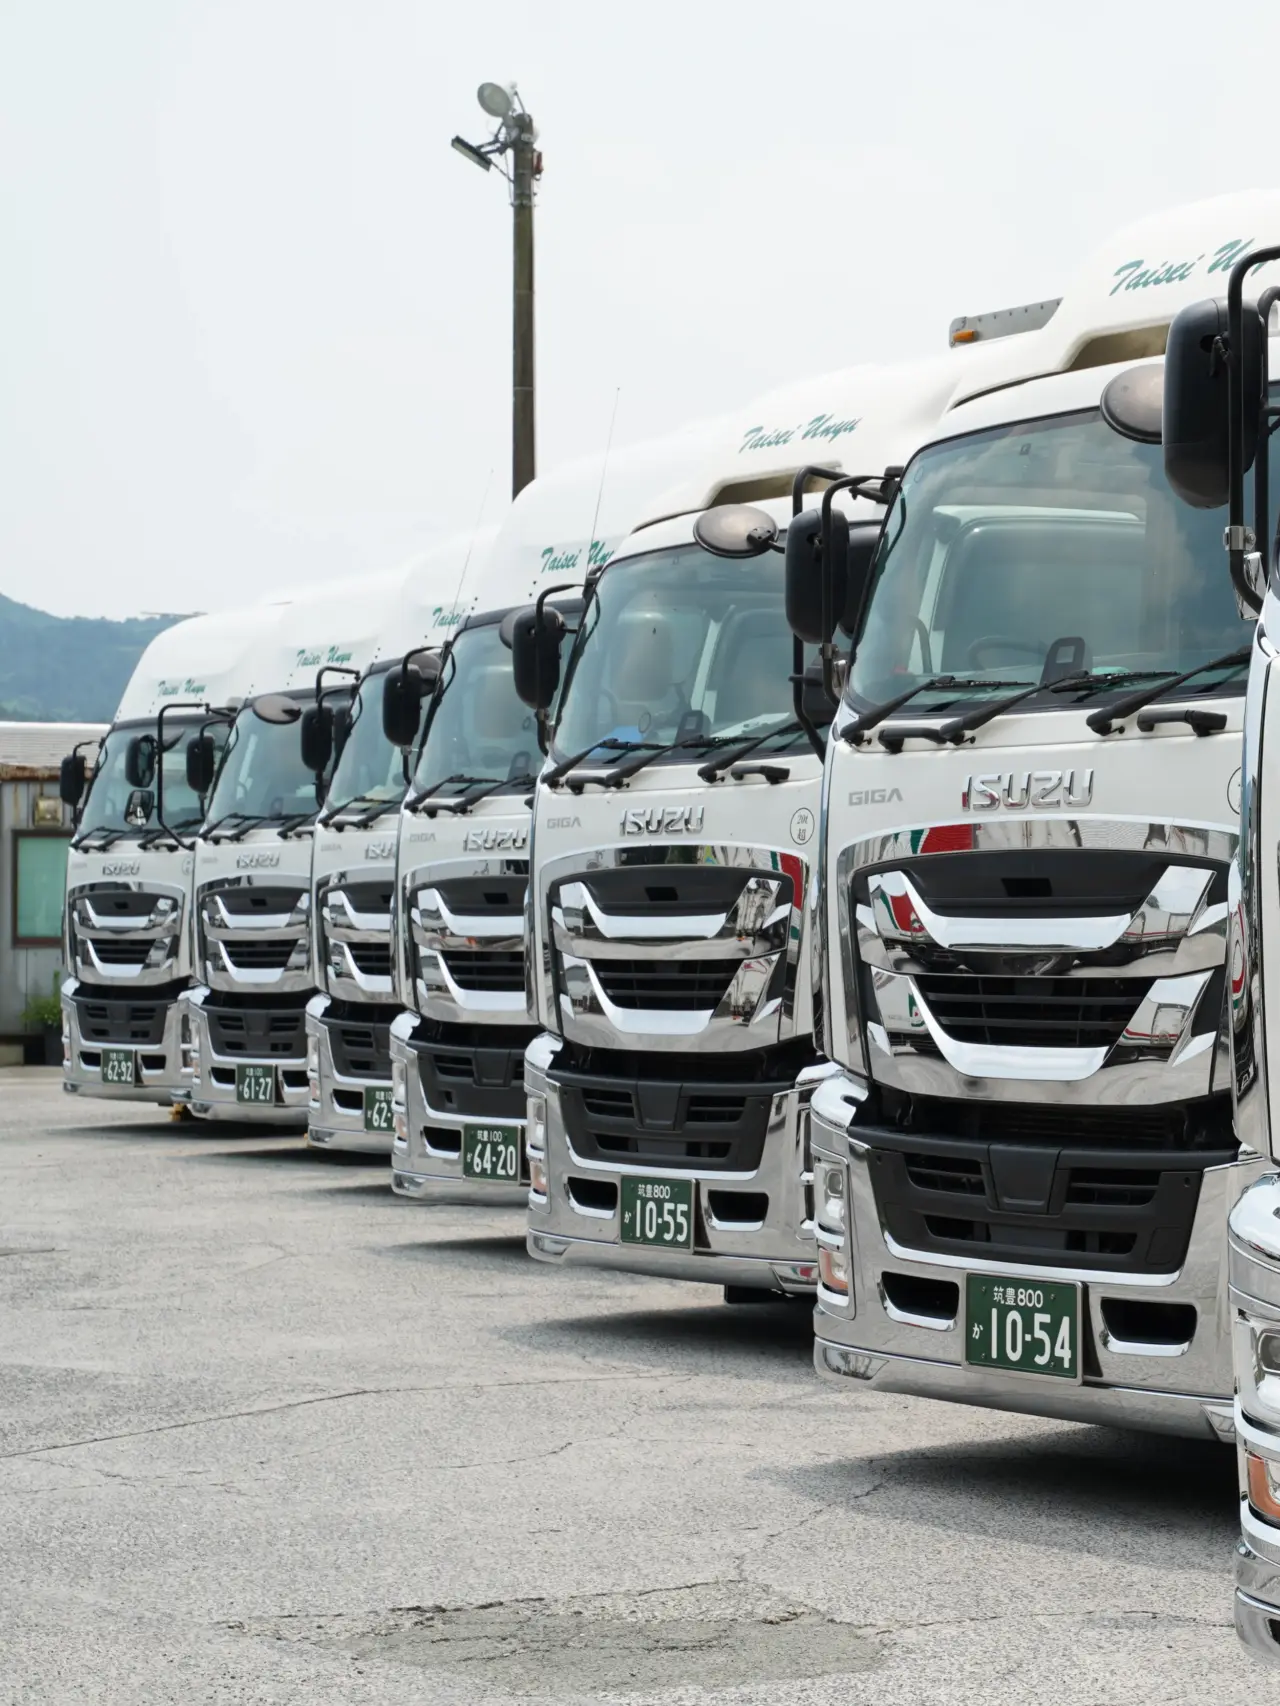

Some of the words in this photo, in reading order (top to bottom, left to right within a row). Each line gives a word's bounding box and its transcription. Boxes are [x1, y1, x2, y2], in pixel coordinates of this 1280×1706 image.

[1109, 254, 1205, 296] Taisei
[739, 424, 802, 454] Taisei
[541, 547, 582, 573] Taisei
[848, 788, 903, 806] GIGA
[962, 769, 1094, 812] ISUZU
[547, 817, 581, 829] GIGA
[620, 805, 705, 836] ISUZU
[365, 841, 396, 860] ISU
[463, 828, 528, 851] ISUZU
[102, 862, 140, 876] ISUZU
[237, 853, 279, 869] ISUZU
[107, 1060, 132, 1081] 62-92
[243, 1076, 272, 1100] 61-27
[372, 1102, 395, 1128] 62-
[473, 1143, 516, 1176] 64-20
[635, 1199, 688, 1242] 10-55
[972, 1322, 983, 1339] か
[991, 1307, 1071, 1368] 10-54
